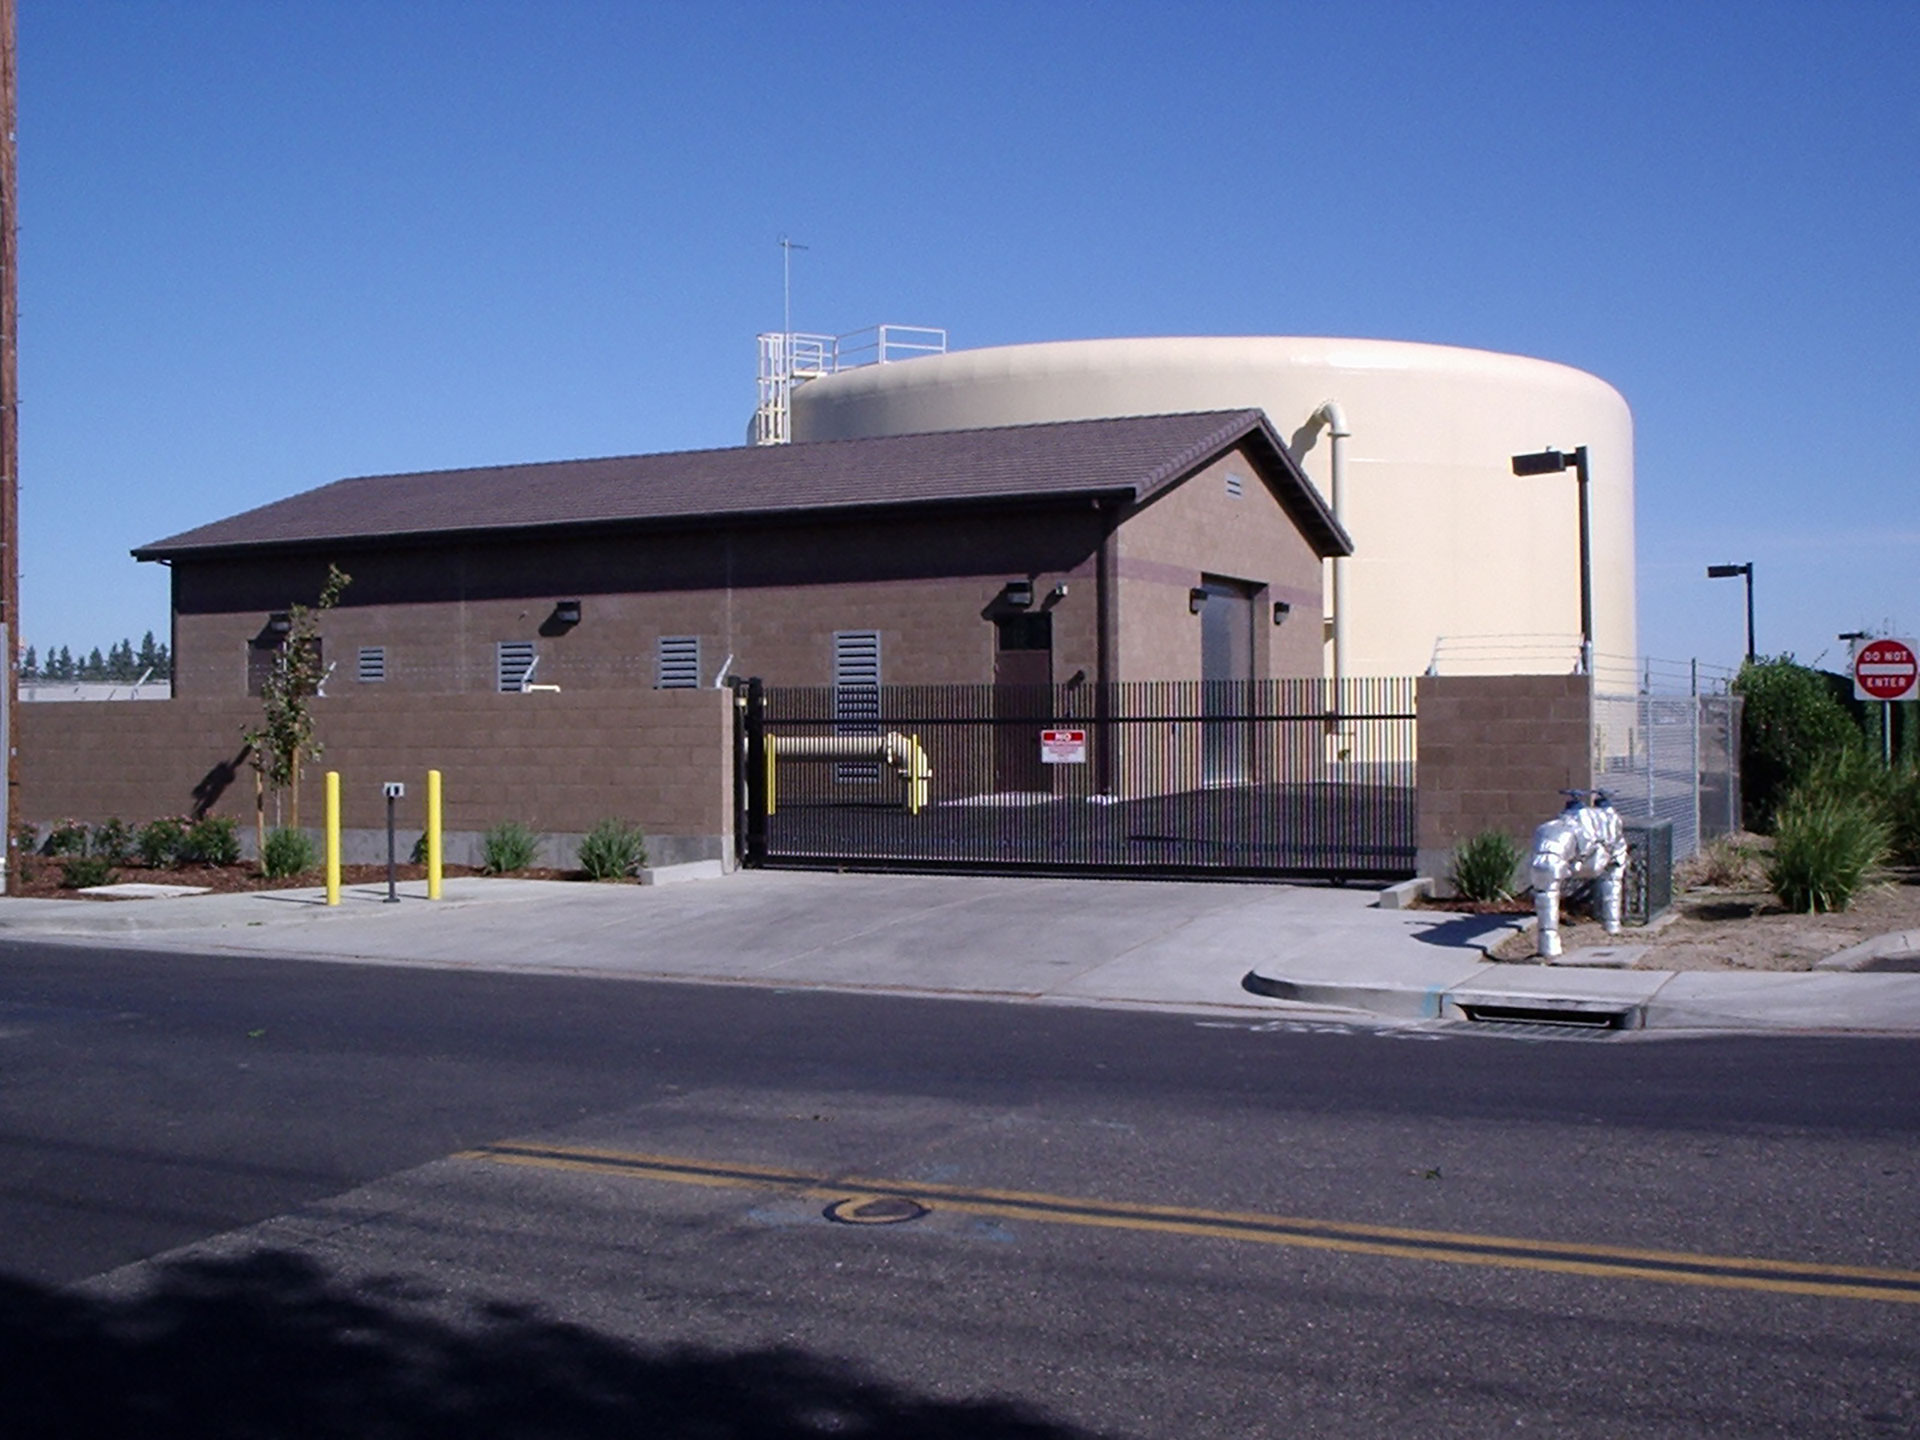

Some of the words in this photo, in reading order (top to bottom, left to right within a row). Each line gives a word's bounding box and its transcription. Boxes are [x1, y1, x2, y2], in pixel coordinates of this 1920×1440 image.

[1864, 651, 1880, 661] DO
[1884, 651, 1907, 661] NOT
[1866, 677, 1906, 688] ENTER
[1055, 732, 1072, 742] NO
